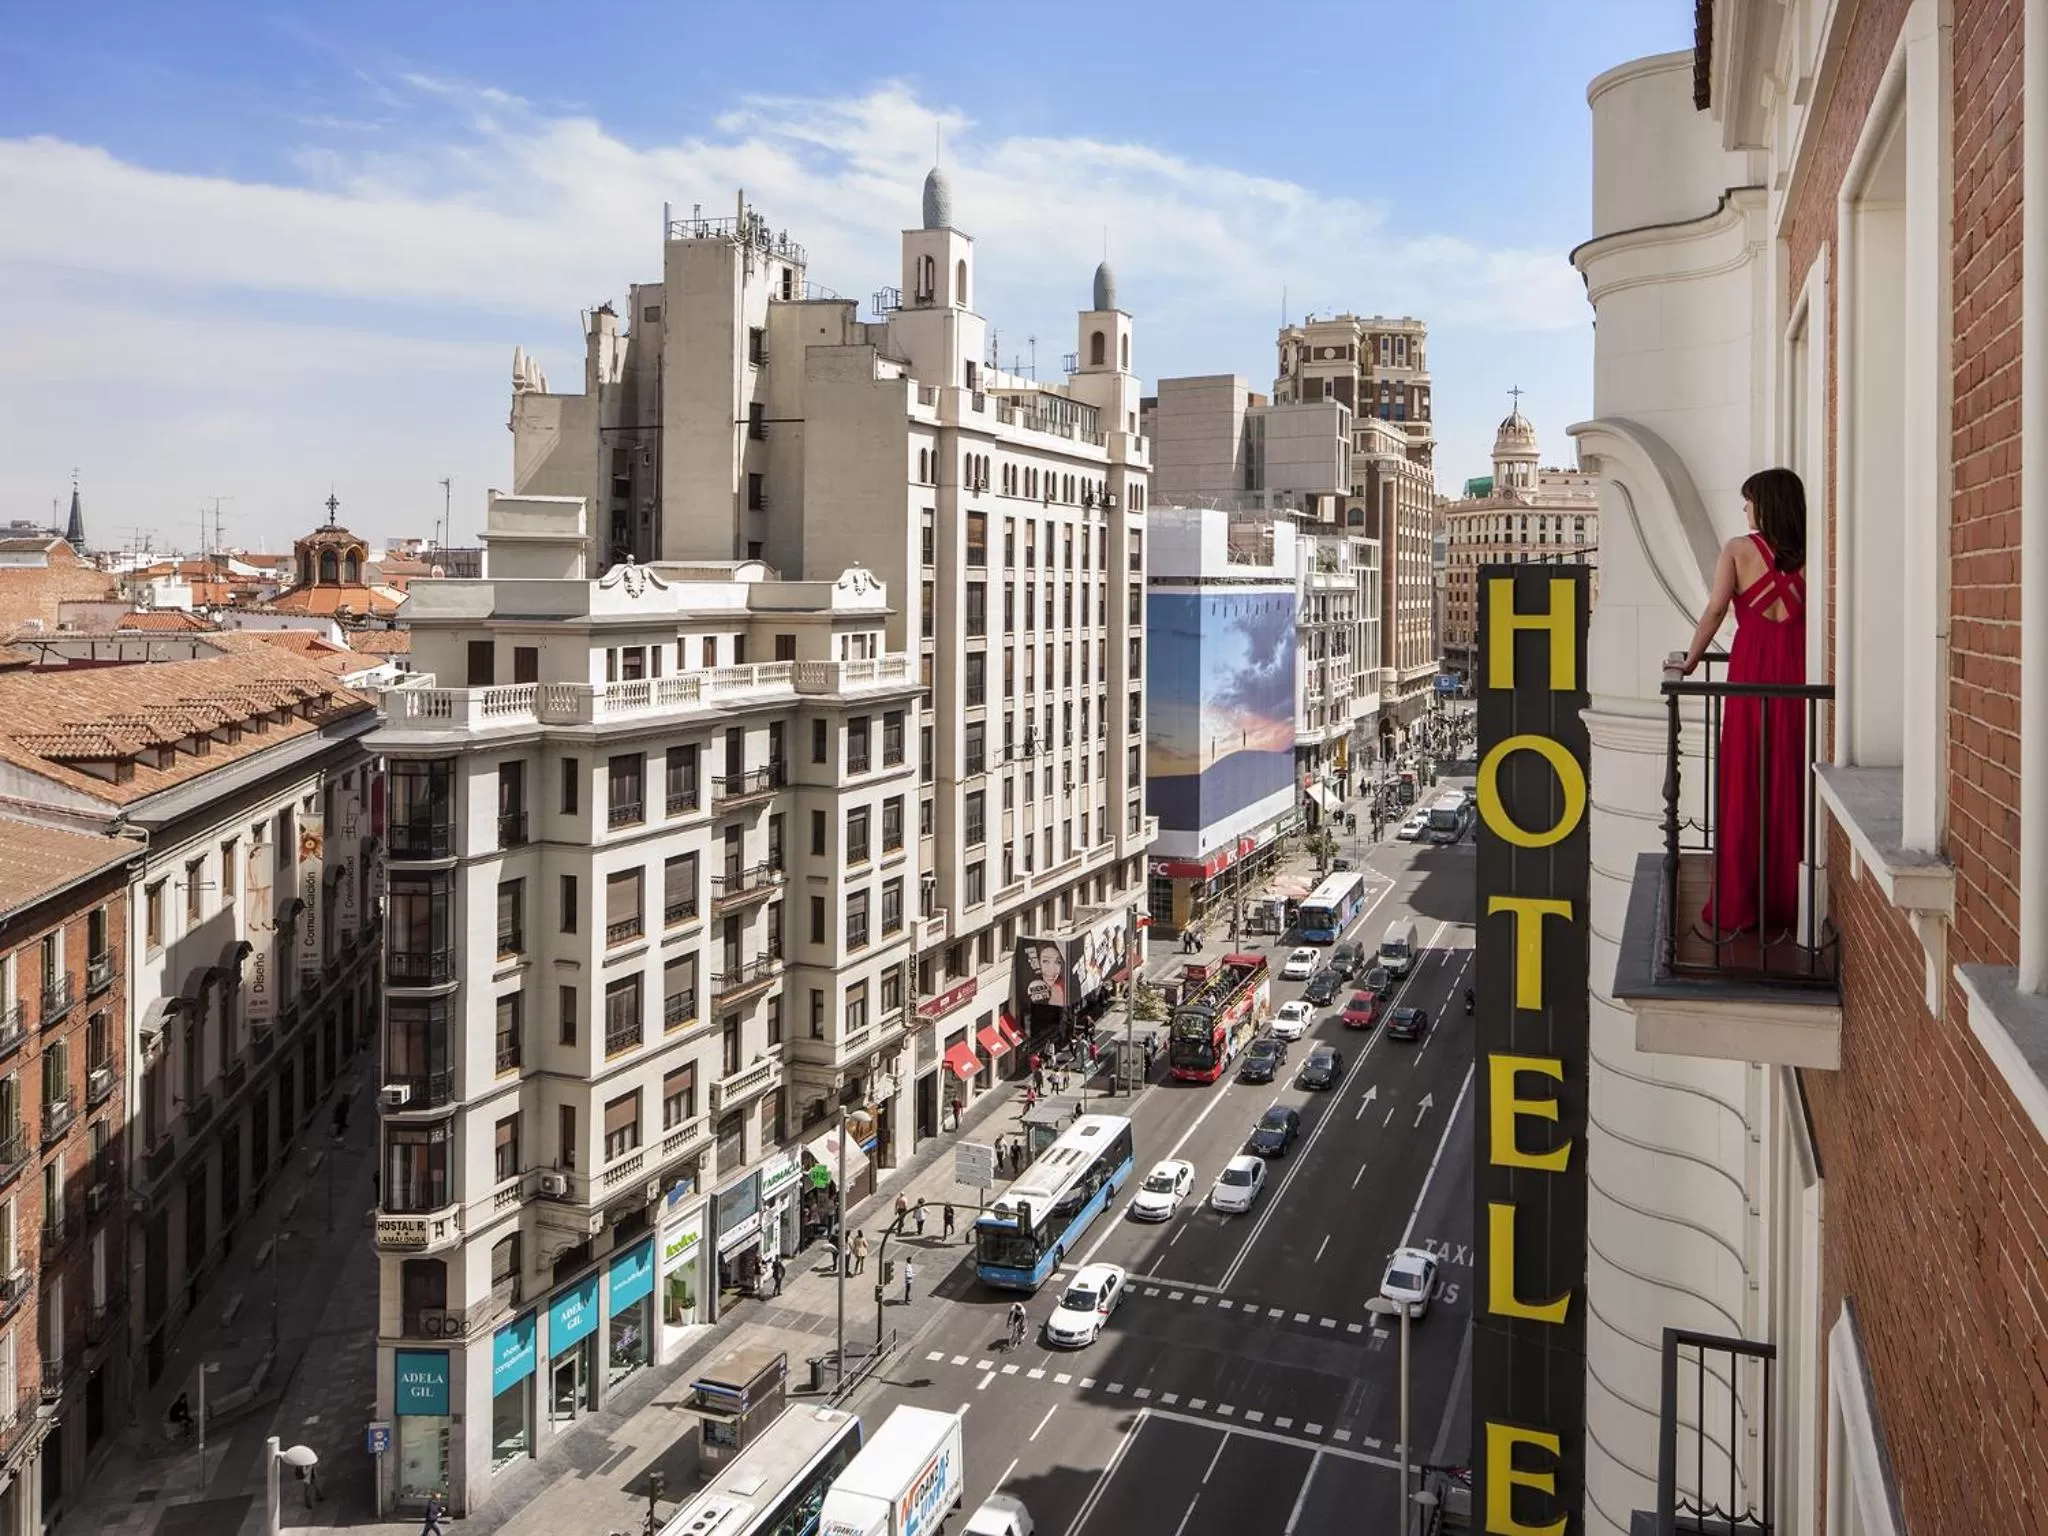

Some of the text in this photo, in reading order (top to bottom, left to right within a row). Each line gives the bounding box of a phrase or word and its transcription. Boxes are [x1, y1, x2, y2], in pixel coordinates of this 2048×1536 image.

[1147, 862, 1170, 876] FC
[304, 871, 316, 947] Comunicación
[253, 952, 265, 993] Diseño
[377, 1221, 414, 1231] HOSTAL
[567, 1316, 583, 1331] GIL
[401, 1373, 444, 1384] ADELA
[411, 1386, 434, 1397] GIL
